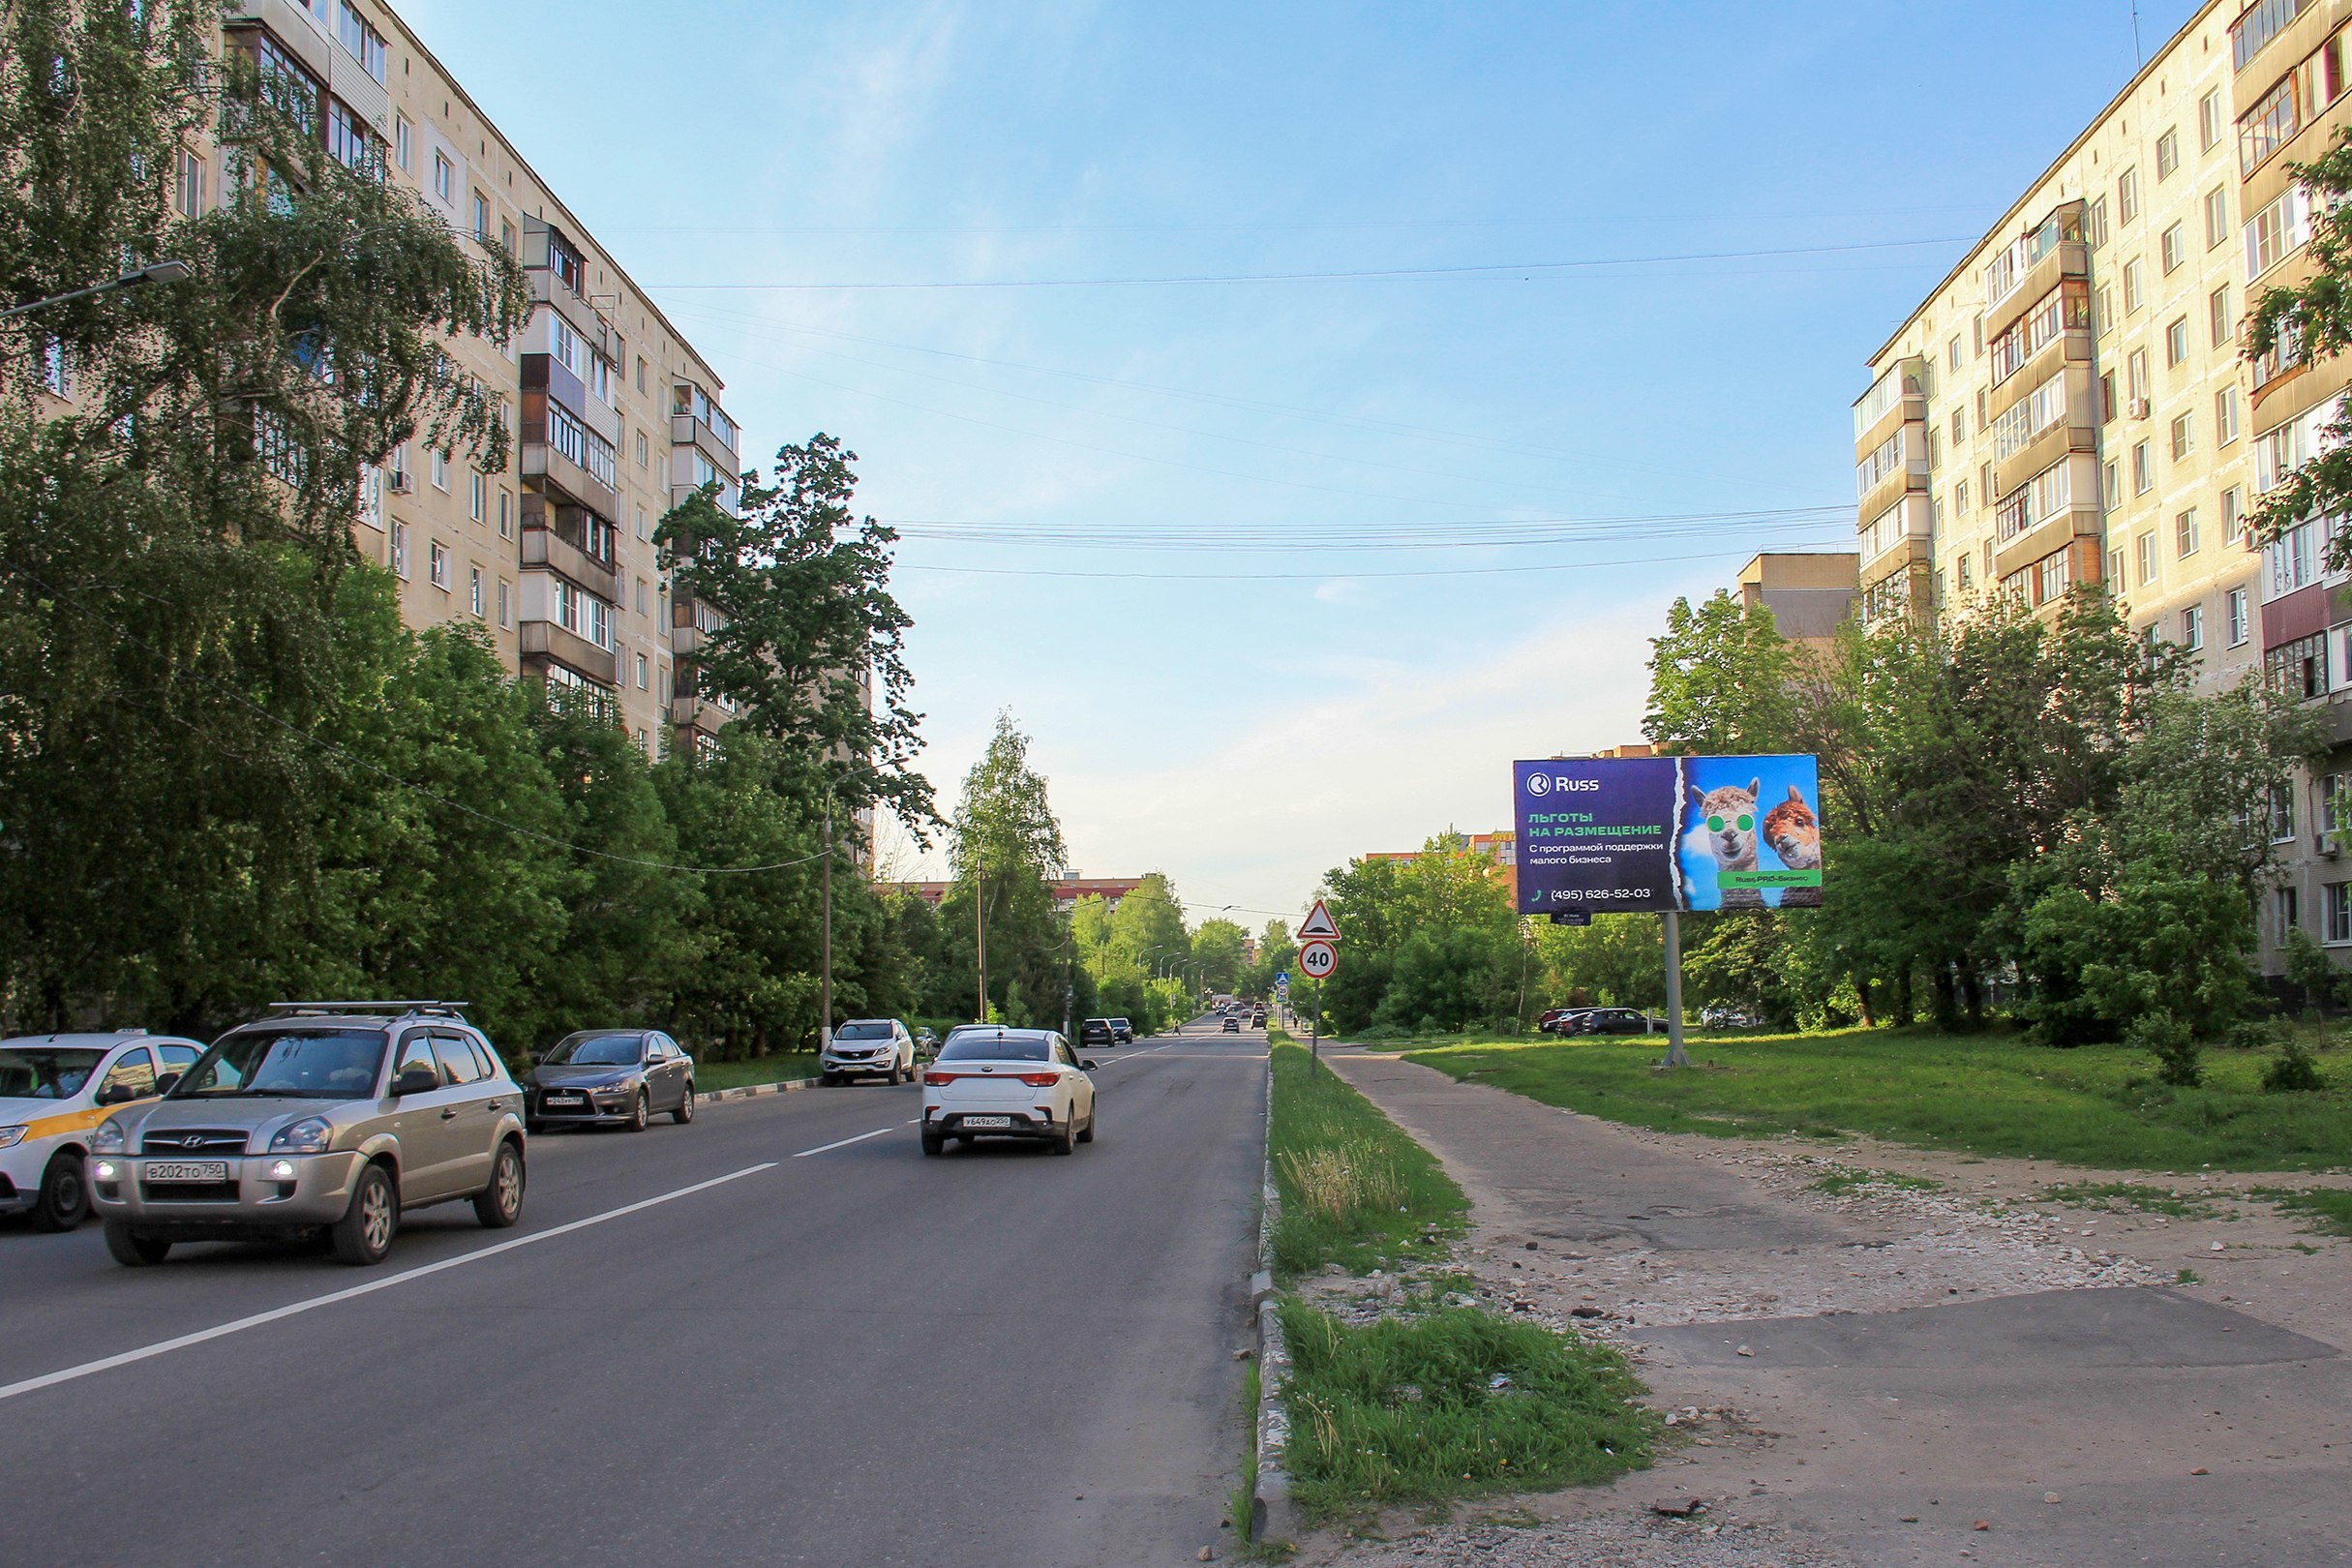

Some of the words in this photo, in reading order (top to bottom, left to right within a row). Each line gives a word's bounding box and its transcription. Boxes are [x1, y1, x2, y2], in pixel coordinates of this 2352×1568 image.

[1555, 776, 1600, 792] Russ
[1528, 812, 1593, 824] ЛЬГОТЫ
[1529, 828, 1552, 837] НА
[1553, 825, 1662, 837] РАЗМЕЩЕНИЕ
[1529, 844, 1538, 853] С
[1539, 843, 1604, 854] программой
[1605, 842, 1664, 853] поддержки
[1529, 857, 1567, 865] малого
[1569, 855, 1612, 864] бизнеса
[1551, 890, 1583, 902] (495)
[1585, 888, 1651, 899] 626-52-03
[1307, 951, 1329, 967] 40
[201, 1163, 223, 1174] 750
